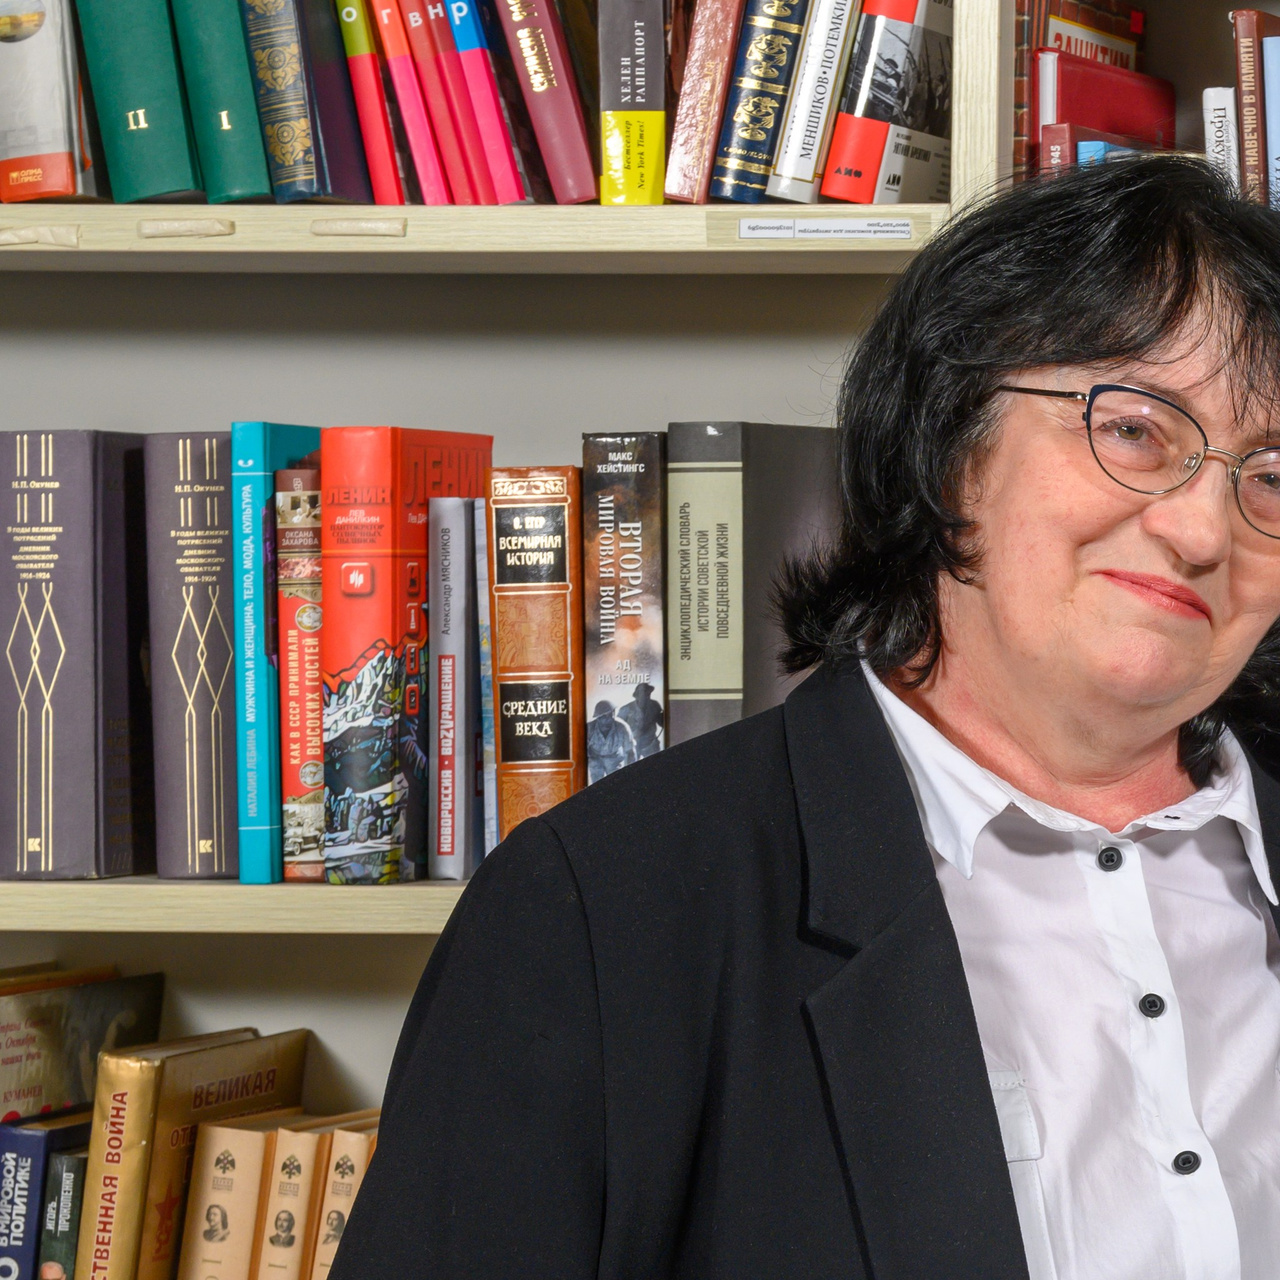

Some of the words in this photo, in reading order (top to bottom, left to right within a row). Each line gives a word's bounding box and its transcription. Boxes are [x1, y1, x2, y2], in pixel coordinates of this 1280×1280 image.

[621, 57, 631, 102] ХЕЛЕН
[634, 20, 646, 103] РАППАПОРТ
[1239, 37, 1254, 91] ПАМЯТИ
[126, 109, 148, 130] II
[1242, 93, 1256, 105] В
[1243, 106, 1259, 165] НАВЕЧНО
[638, 152, 646, 172] York
[638, 173, 646, 190] New
[597, 461, 645, 474] ХЕЙСТИНГС
[608, 451, 634, 461] МАКС
[326, 485, 391, 506] ЛЕНИН
[336, 516, 380, 524] ДАНИЛКИН
[598, 494, 615, 582] МИРОВАЯ
[680, 502, 690, 548] СЛОВАРЬ
[281, 538, 318, 546] ЗАХАРОВА
[441, 527, 452, 578] МЯСНИКОВ
[500, 534, 562, 550] ВСЕМИРНАЯ
[506, 552, 554, 566] ИСТОРИЯ
[696, 530, 710, 588] СОВЕТСКОЙ
[717, 522, 728, 562] ЖИЗНИ
[619, 520, 644, 618] ВТОРАЯ
[441, 580, 454, 635] Александр
[600, 585, 618, 646] ВОЙНА
[680, 550, 692, 661] ЭНЦИКЛОПЕДИЧЕСКИЙ
[697, 590, 710, 632] ИСТОРИИ
[716, 563, 730, 639] ПОВСЕДНЕВНОЙ
[288, 629, 300, 696] ПРИНИМАЛИ
[304, 638, 320, 687] ГОСТЕЙ
[598, 673, 612, 685] НА
[614, 672, 651, 685] ЗЕМЛЕ
[615, 660, 632, 671] АД
[289, 700, 300, 728] СССР
[306, 692, 320, 756] ВЫСОКИХ
[502, 699, 568, 718] СРЕДНИЕ
[514, 720, 553, 738] ВЕКА
[289, 742, 301, 765] КАК
[192, 1067, 278, 1111] ВЕЛИКАЯ
[105, 1090, 129, 1166] ВОЙНА
[10, 1157, 32, 1247] ПОЛИТИКЕ
[46, 1200, 57, 1232] ИГОРЬ
[59, 1171, 75, 1232] ПРОКОПЕНКО
